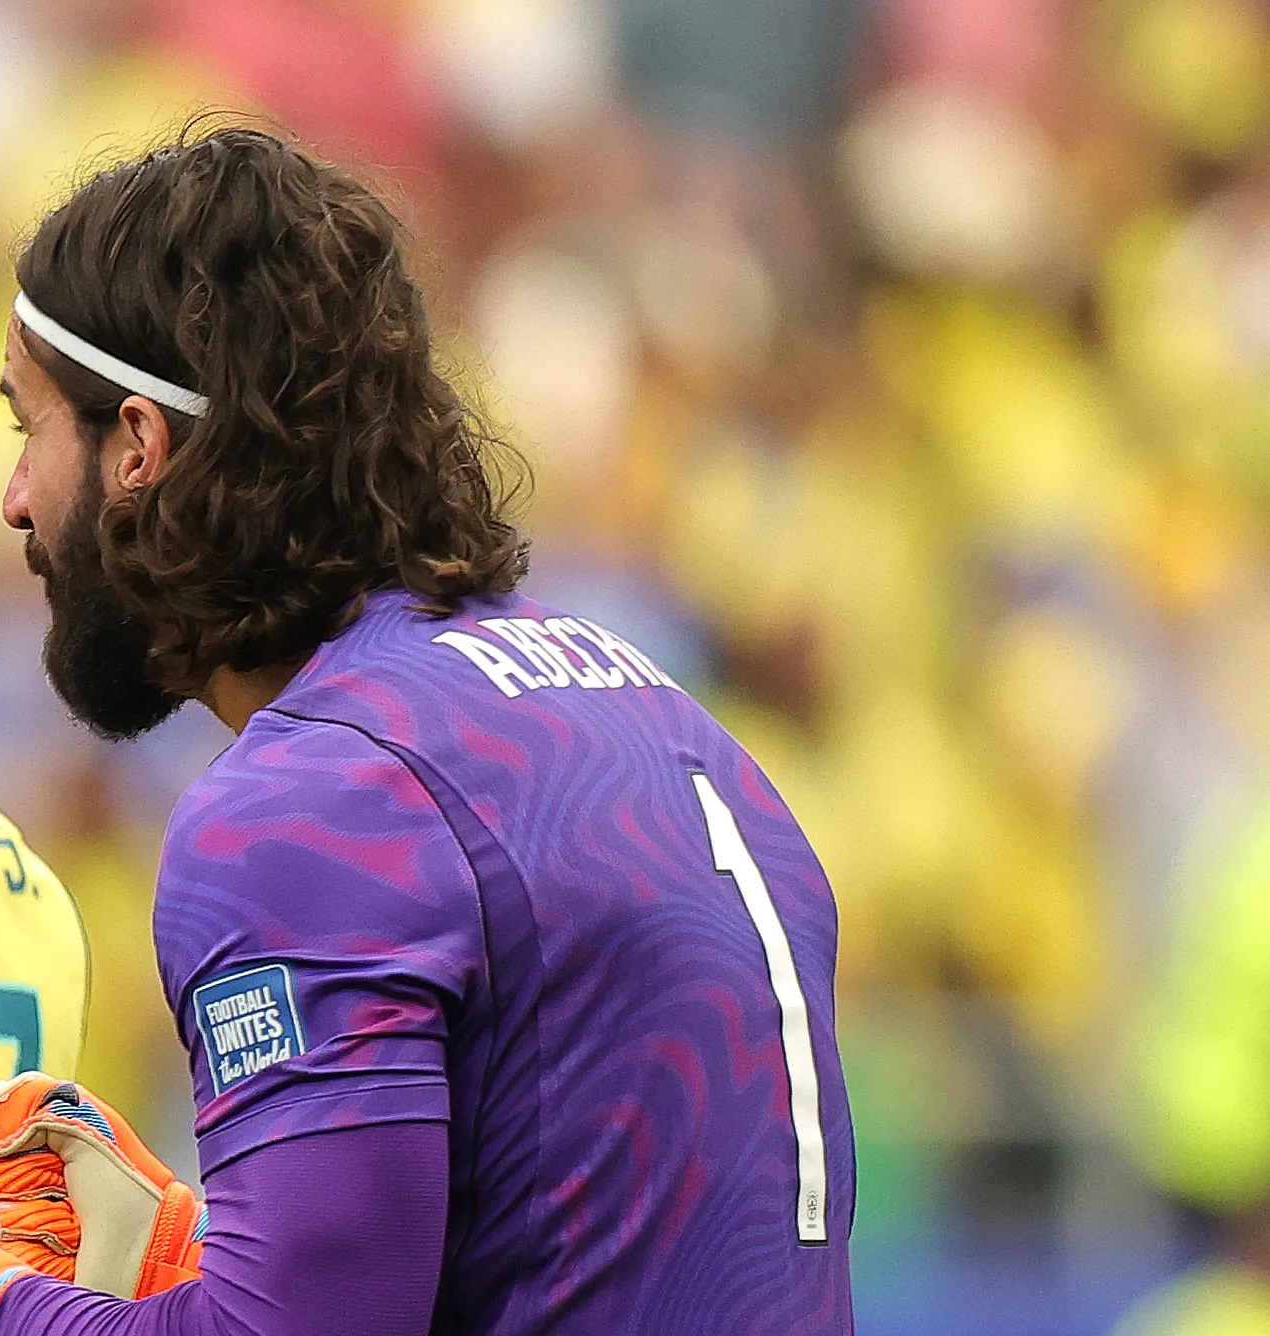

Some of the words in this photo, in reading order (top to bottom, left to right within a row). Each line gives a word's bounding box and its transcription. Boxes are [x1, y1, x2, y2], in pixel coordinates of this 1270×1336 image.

[205, 985, 278, 1026] FOOTBALL
[690, 769, 828, 1246] 1
[211, 1008, 284, 1056] UNITES
[217, 1055, 243, 1085] the
[240, 1037, 292, 1076] World
